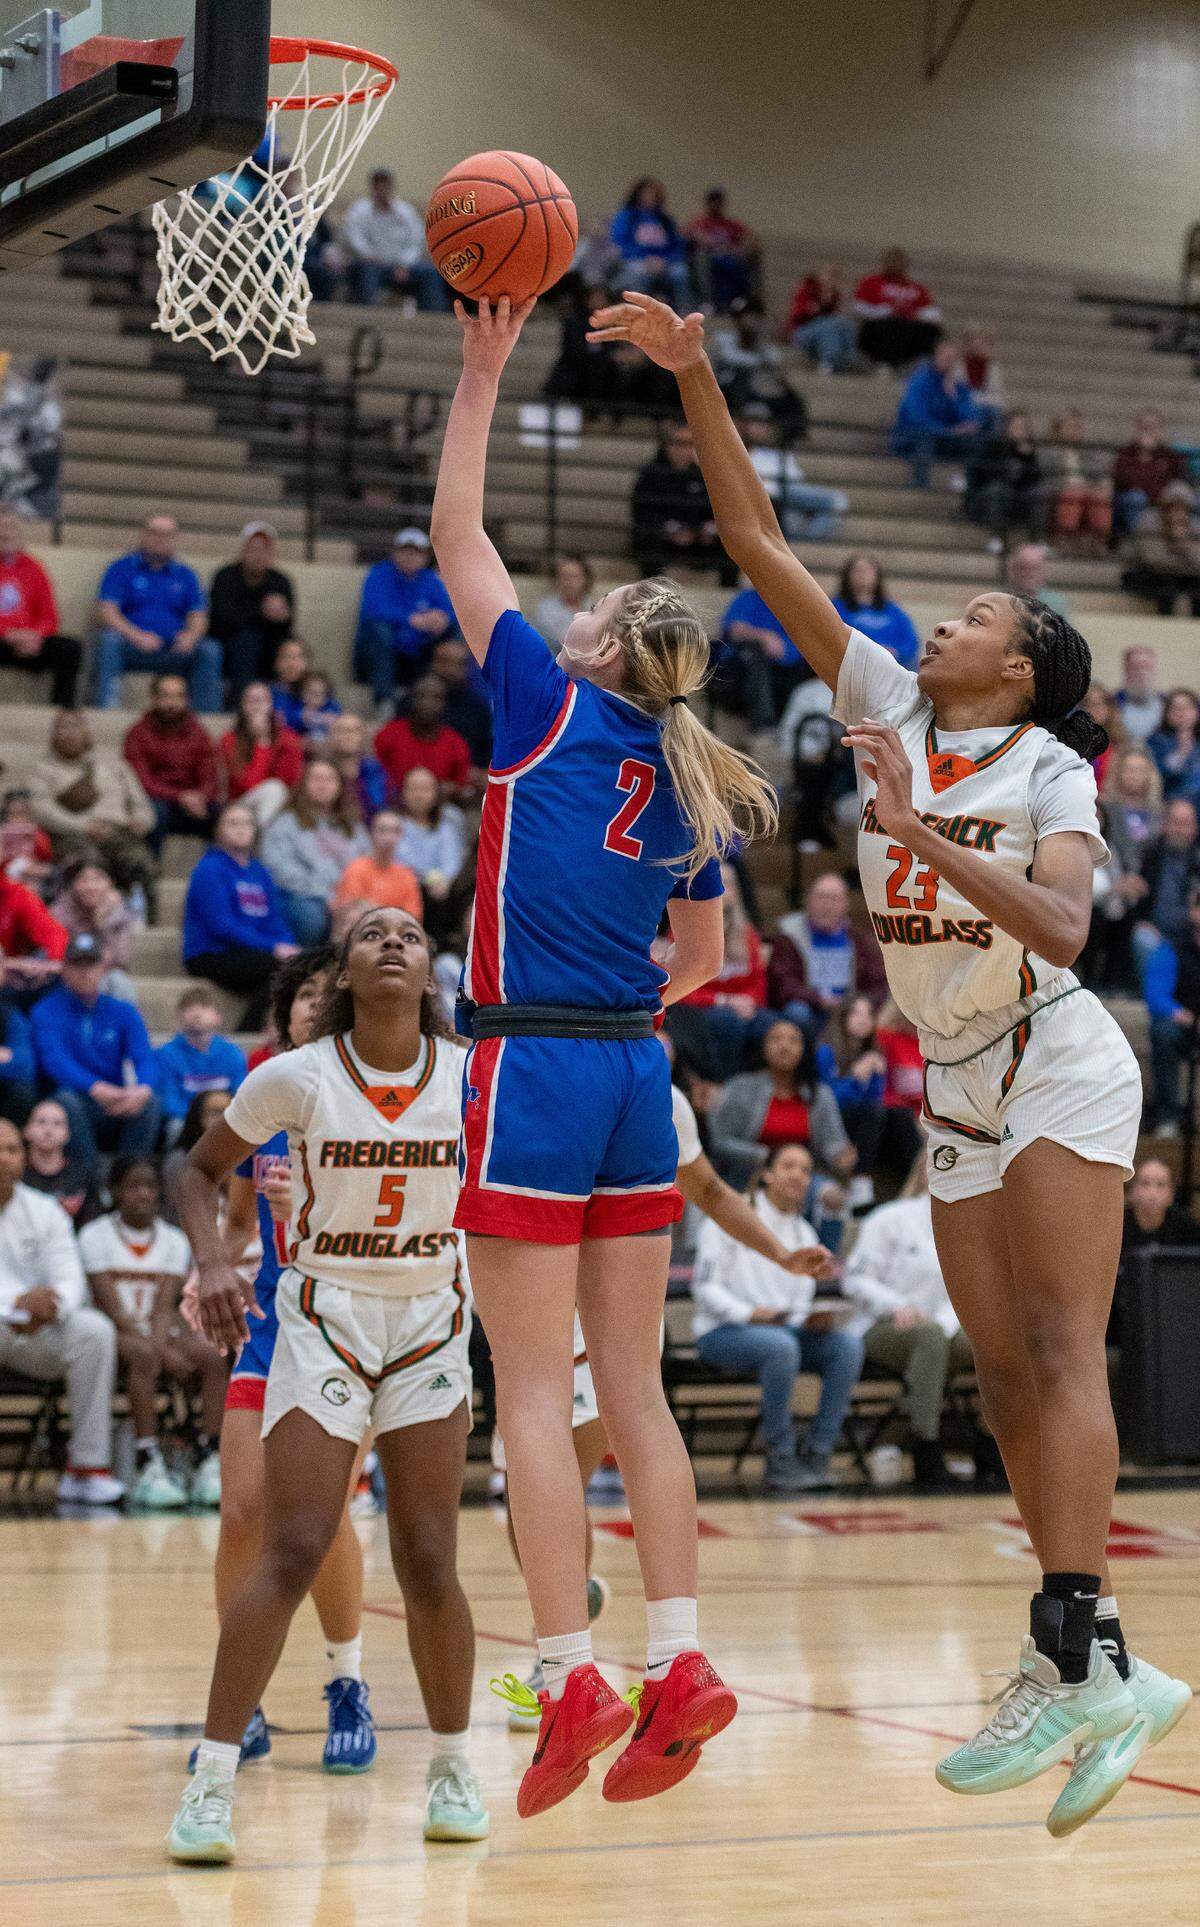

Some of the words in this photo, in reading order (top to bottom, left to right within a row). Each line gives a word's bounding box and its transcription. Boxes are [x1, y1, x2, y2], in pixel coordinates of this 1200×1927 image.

[603, 758, 656, 861] 2
[886, 845, 939, 911] 23
[319, 1139, 459, 1168] FREDERICK
[373, 1174, 407, 1227] 5
